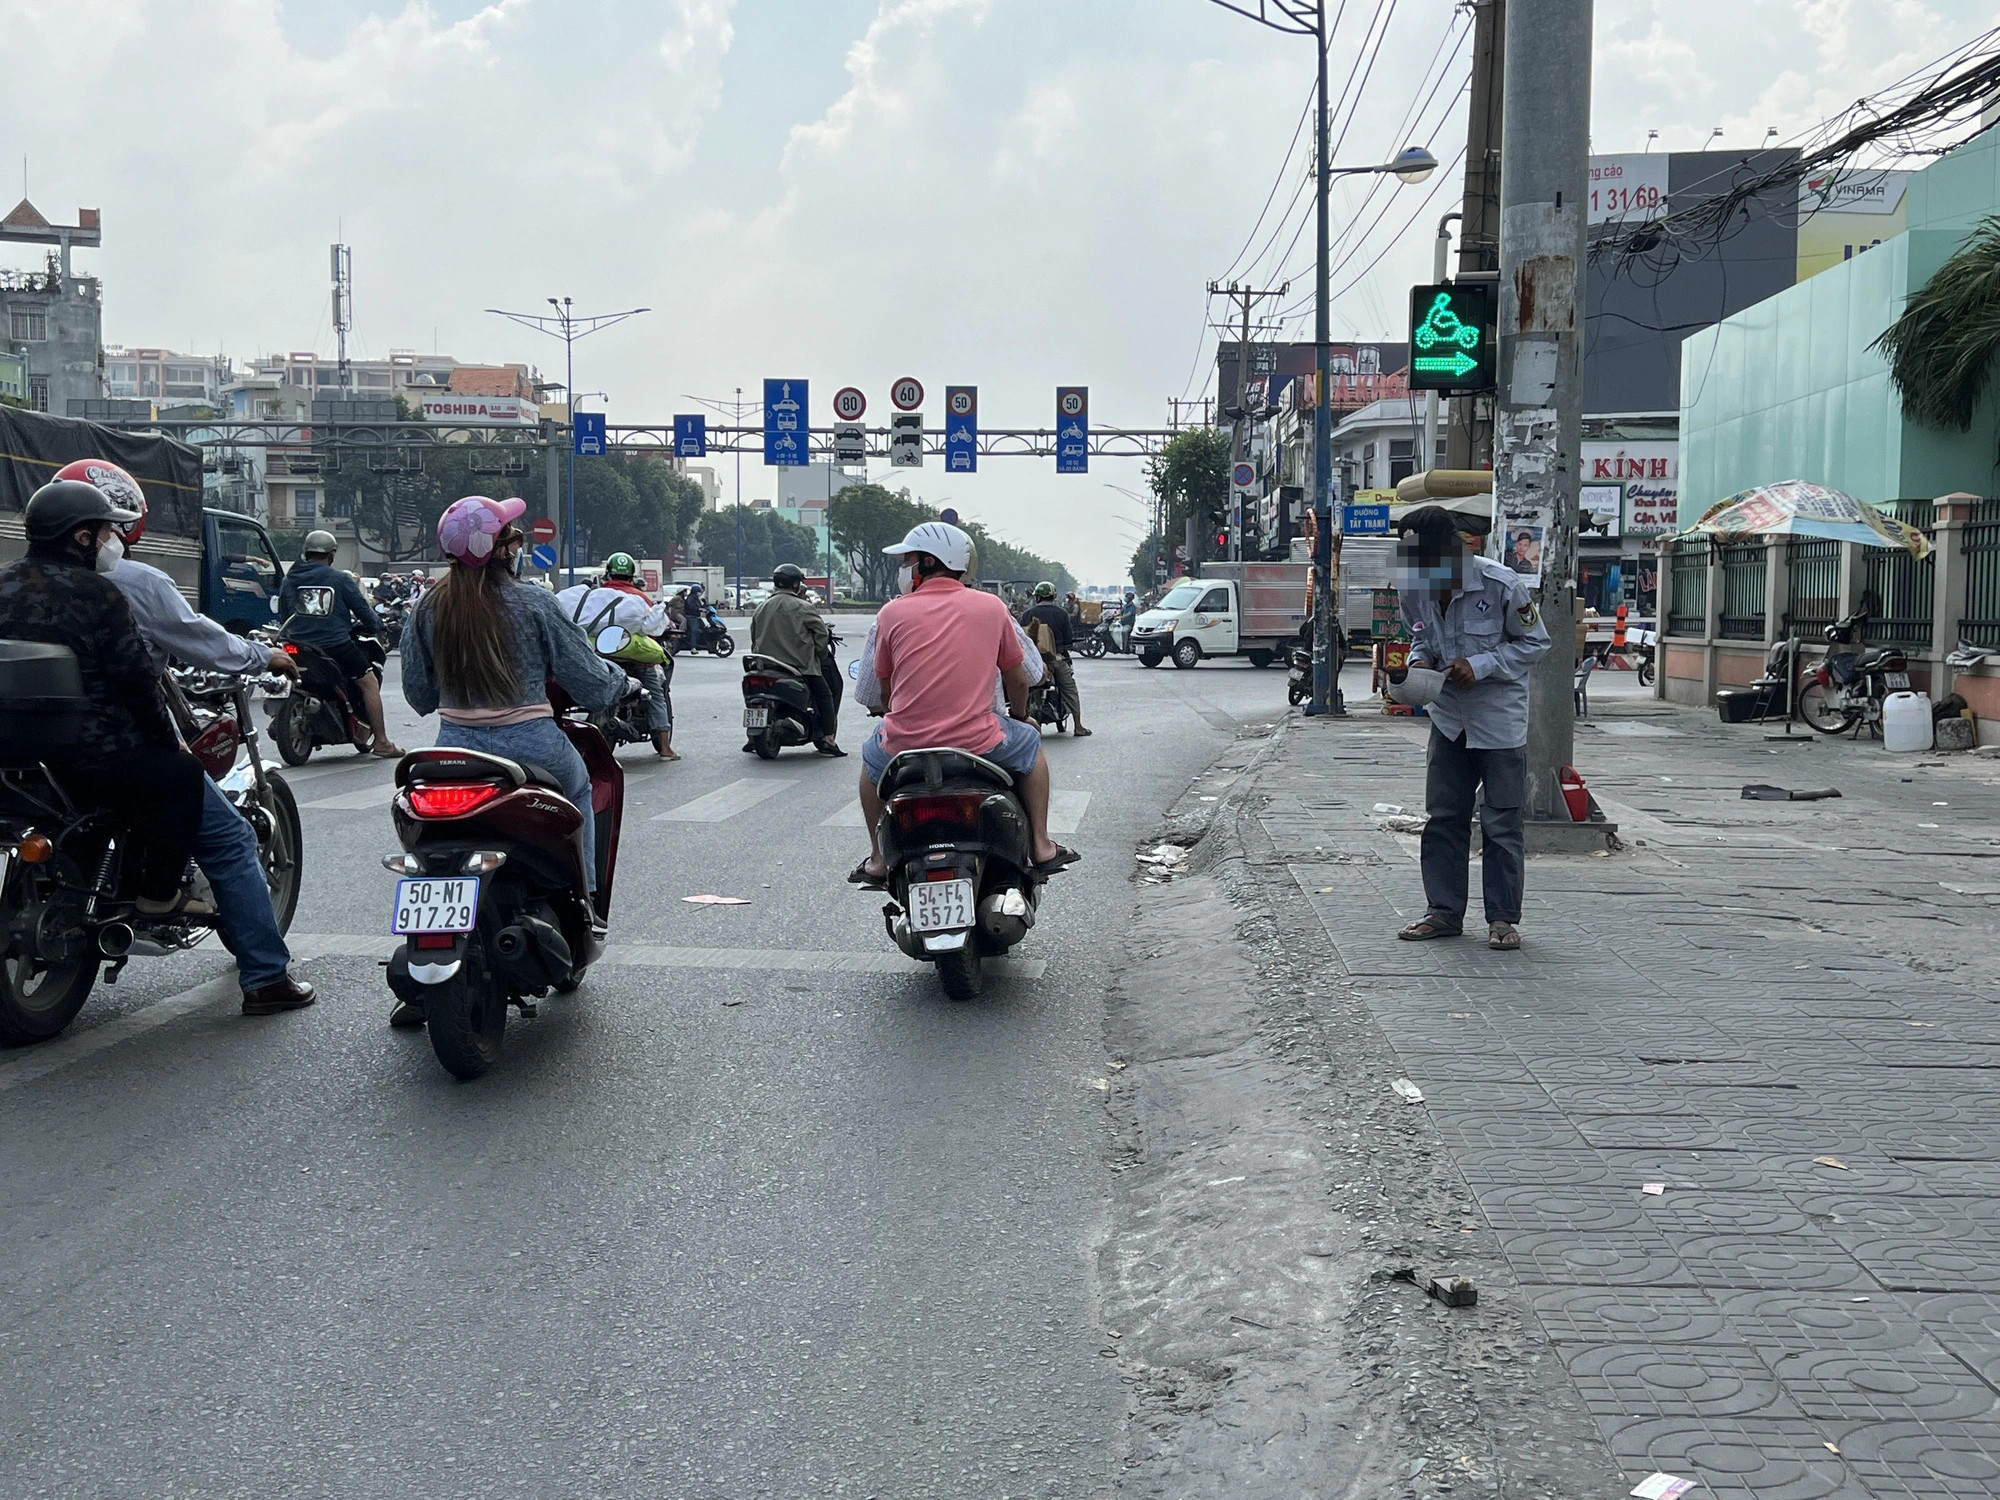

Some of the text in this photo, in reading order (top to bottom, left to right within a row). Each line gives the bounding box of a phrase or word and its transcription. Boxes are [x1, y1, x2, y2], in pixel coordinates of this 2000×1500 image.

[1604, 163, 1623, 177] cáo
[900, 387, 915, 402] 60
[424, 403, 488, 415] TOSHIBA
[842, 397, 857, 411] 80
[955, 396, 967, 409] 50
[1066, 397, 1078, 410] 50
[1594, 451, 1668, 478] KÍNH
[1353, 508, 1379, 516] ĐƯỜNG
[1350, 517, 1386, 530] TÂY THẠNH
[409, 881, 463, 904] 50-N1
[918, 883, 964, 906] 54-F4
[398, 905, 471, 929] 917.29
[920, 904, 965, 927] 5572
